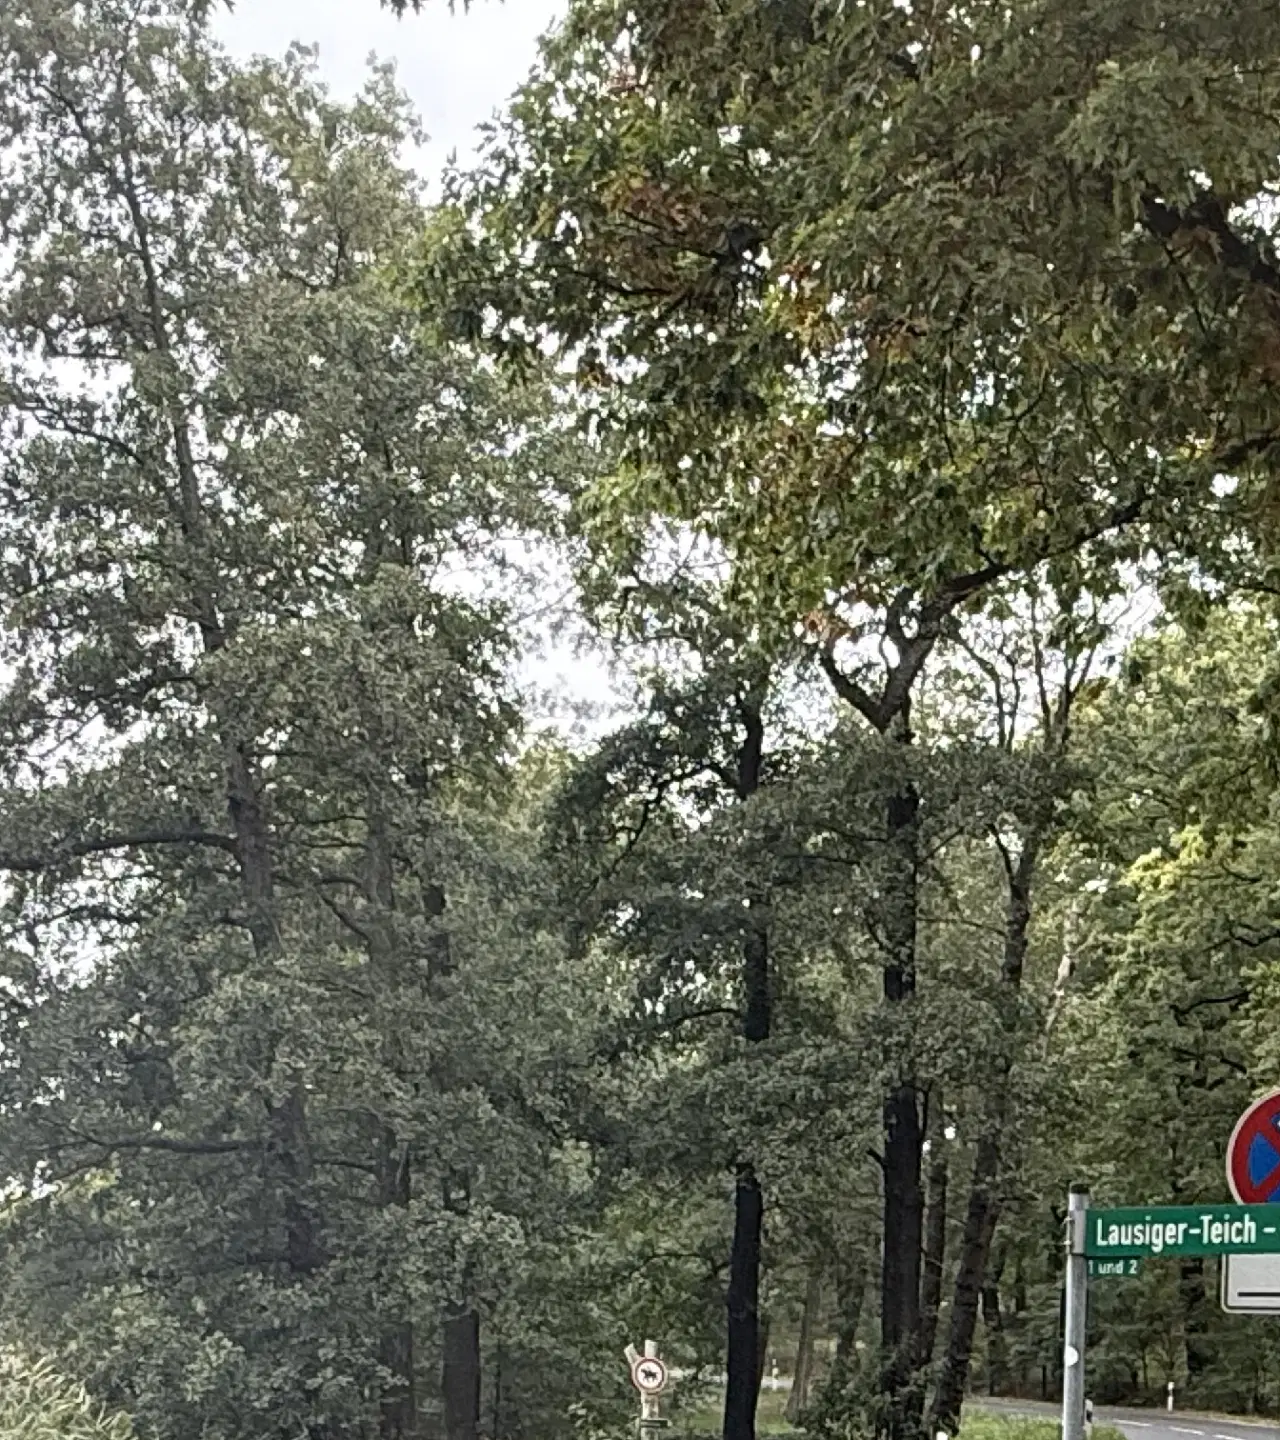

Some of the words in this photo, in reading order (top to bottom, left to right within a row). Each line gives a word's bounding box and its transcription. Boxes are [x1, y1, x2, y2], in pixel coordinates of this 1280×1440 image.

[1088, 1260, 1094, 1274] 1
[1098, 1260, 1124, 1275] und
[1129, 1259, 1138, 1275] 2
